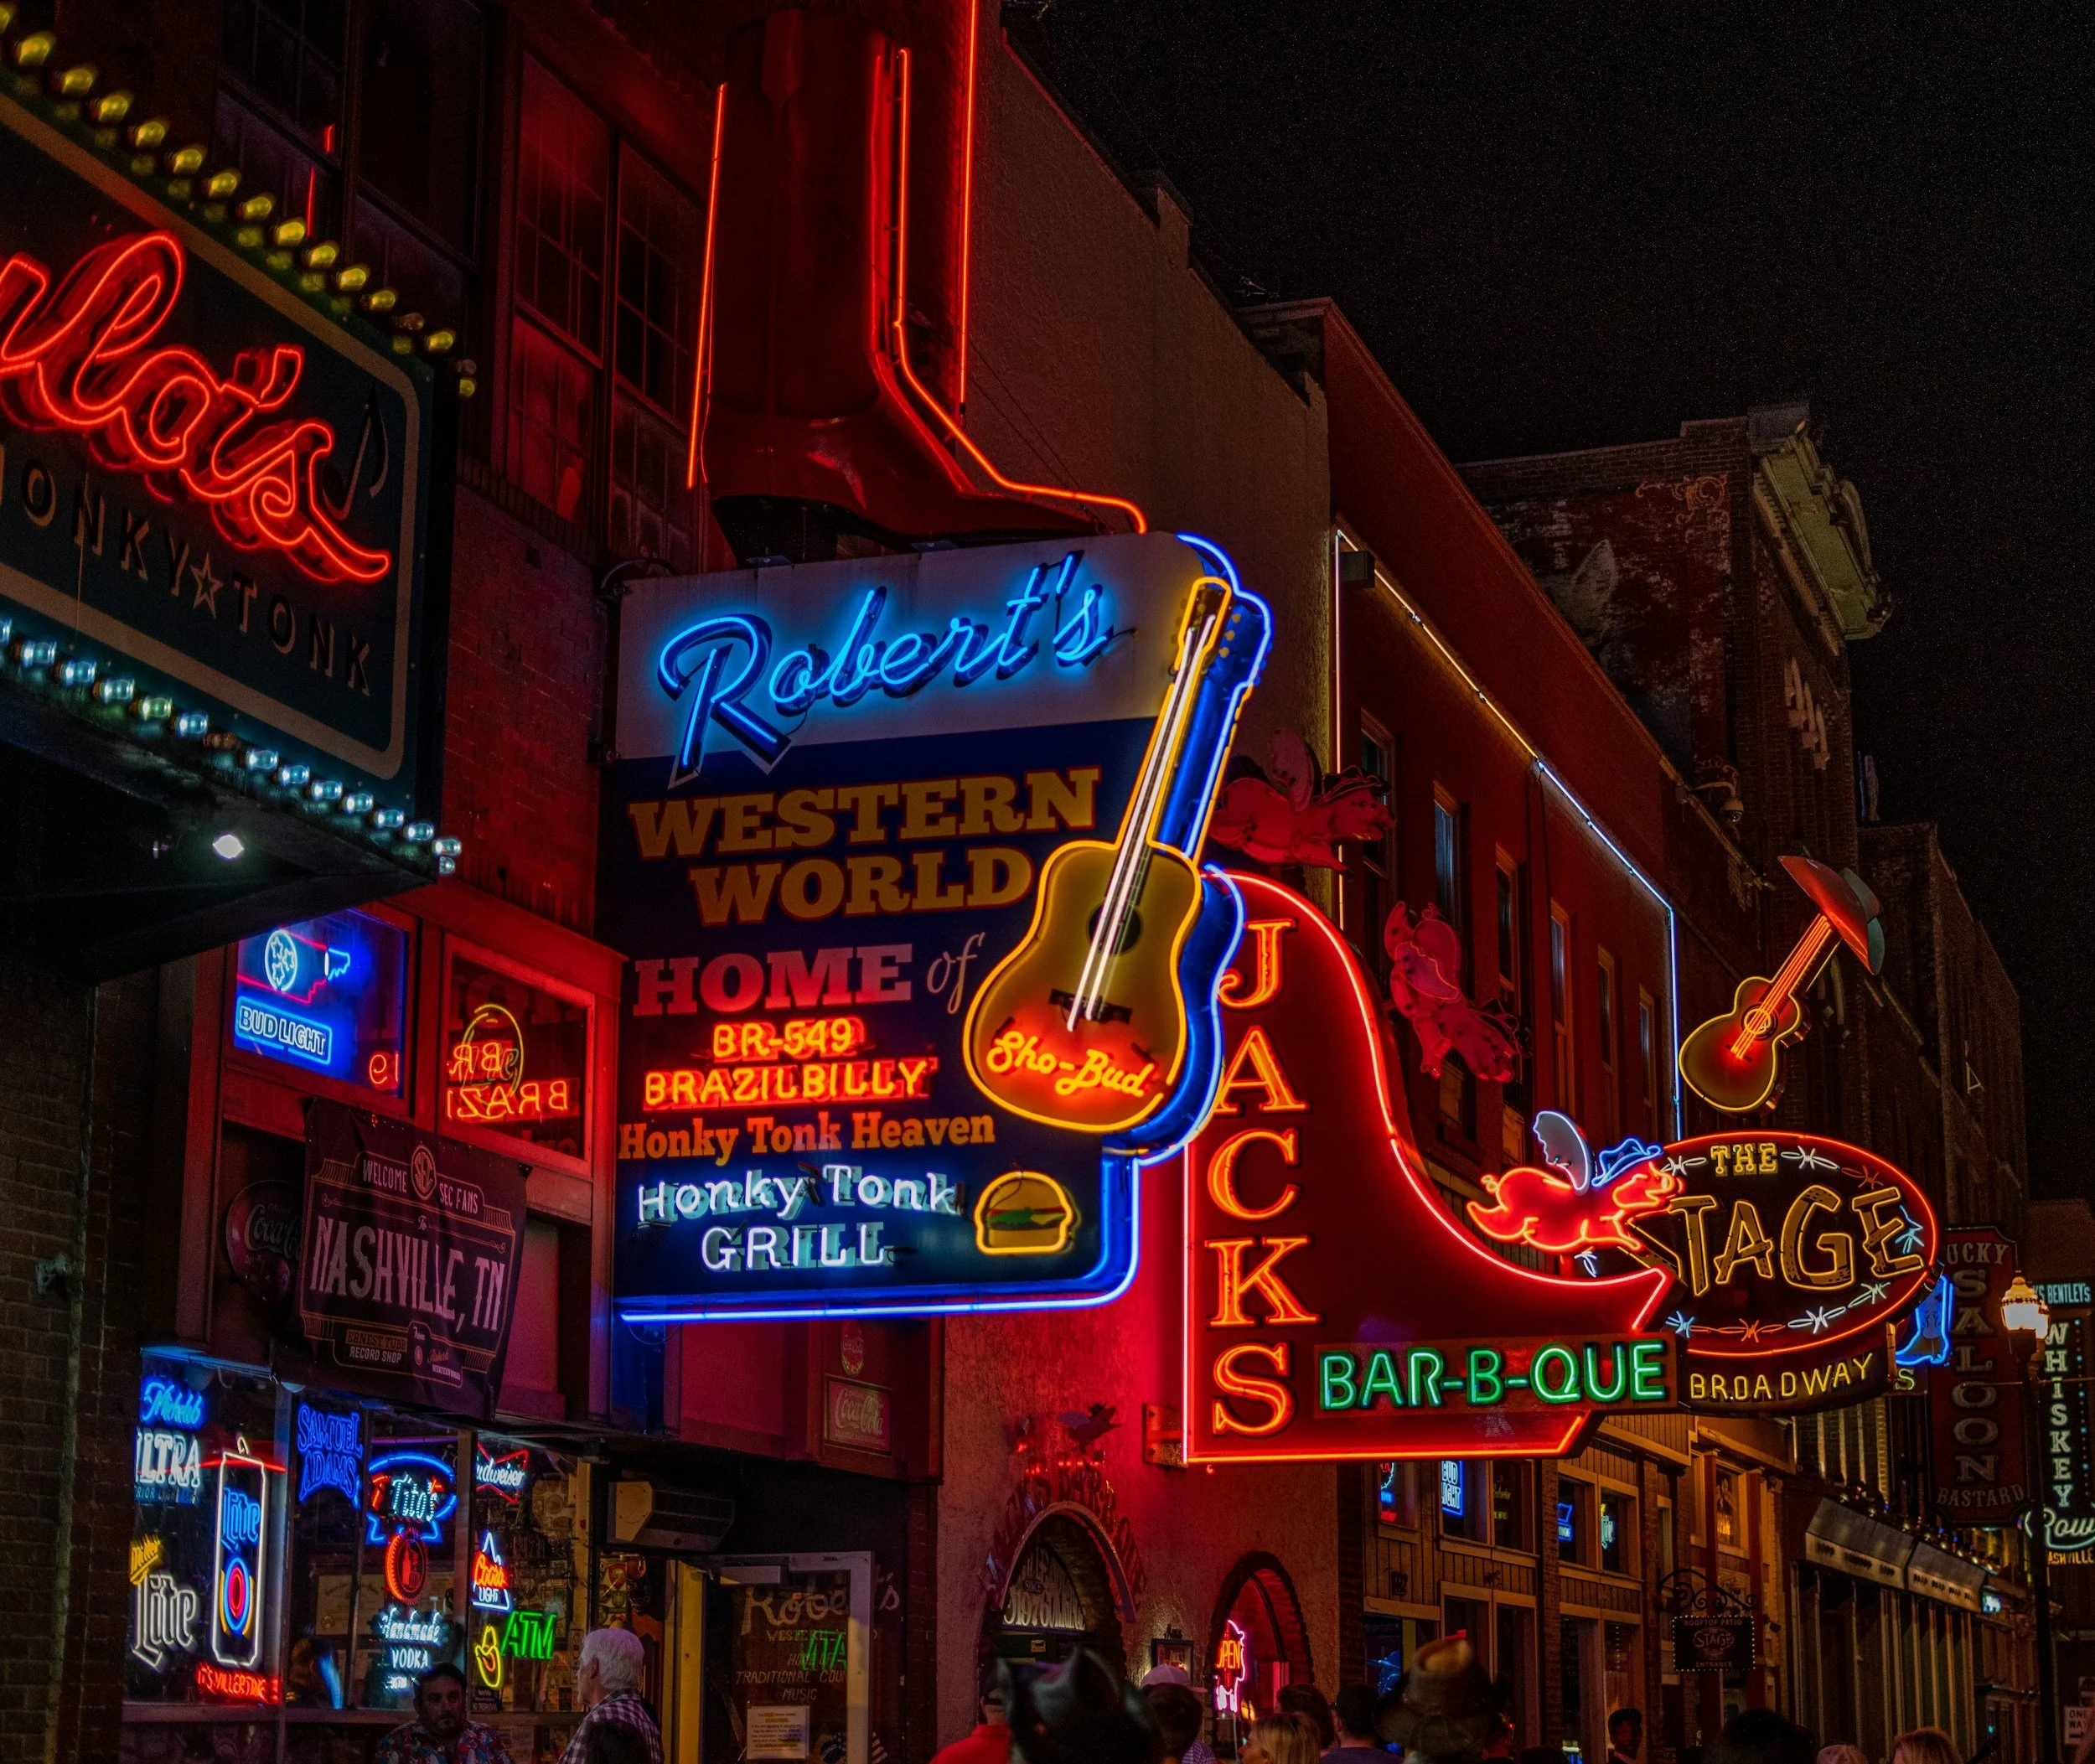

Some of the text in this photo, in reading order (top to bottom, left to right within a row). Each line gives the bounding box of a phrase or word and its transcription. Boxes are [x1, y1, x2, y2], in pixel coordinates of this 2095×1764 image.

[0, 444, 370, 697] ONKY TONK
[659, 550, 1113, 784] Robert's
[628, 767, 1101, 860] WESTERN
[689, 845, 1035, 928] WORLD
[633, 932, 985, 1016] HOME of
[238, 1005, 327, 1057] BUD LIGHT
[712, 1016, 866, 1063] BR-549
[644, 1058, 935, 1110] BRAZILBILLY
[986, 1030, 1158, 1098] Sho-Bud
[619, 1111, 995, 1167] Honky Tonk Heaven
[1710, 1143, 1777, 1175] THE
[362, 1159, 408, 1194] WELCOME
[438, 1182, 454, 1207] SEC
[455, 1185, 478, 1214] FANS
[637, 1164, 964, 1229] Honky Tonk
[309, 1214, 506, 1334] NASHVILLE, TN
[701, 1222, 895, 1272] GRILL
[1946, 1242, 2010, 1267] UCKY
[349, 1345, 403, 1364] RECORD SHOP
[1318, 1339, 1669, 1411] BAR-B-QUE
[1689, 1352, 1874, 1401] BROADWAY
[1950, 1268, 1999, 1483] SALOON
[297, 1402, 364, 1461] SAMUEL
[2044, 1320, 2075, 1508] WHISKEY
[298, 1449, 362, 1508] ADAMS
[1936, 1482, 2025, 1509] BASTARD
[222, 1487, 261, 1551] Lite
[132, 1574, 197, 1668] Lite
[501, 1609, 558, 1661] ATM
[1684, 1618, 1743, 1627] ROOFTOP PATIO
[391, 1647, 429, 1669] VODKA
[736, 1669, 813, 1684] TRADITIONAL
[1695, 1660, 1733, 1668] ENTRANCE
[782, 1687, 818, 1701] MUSIC
